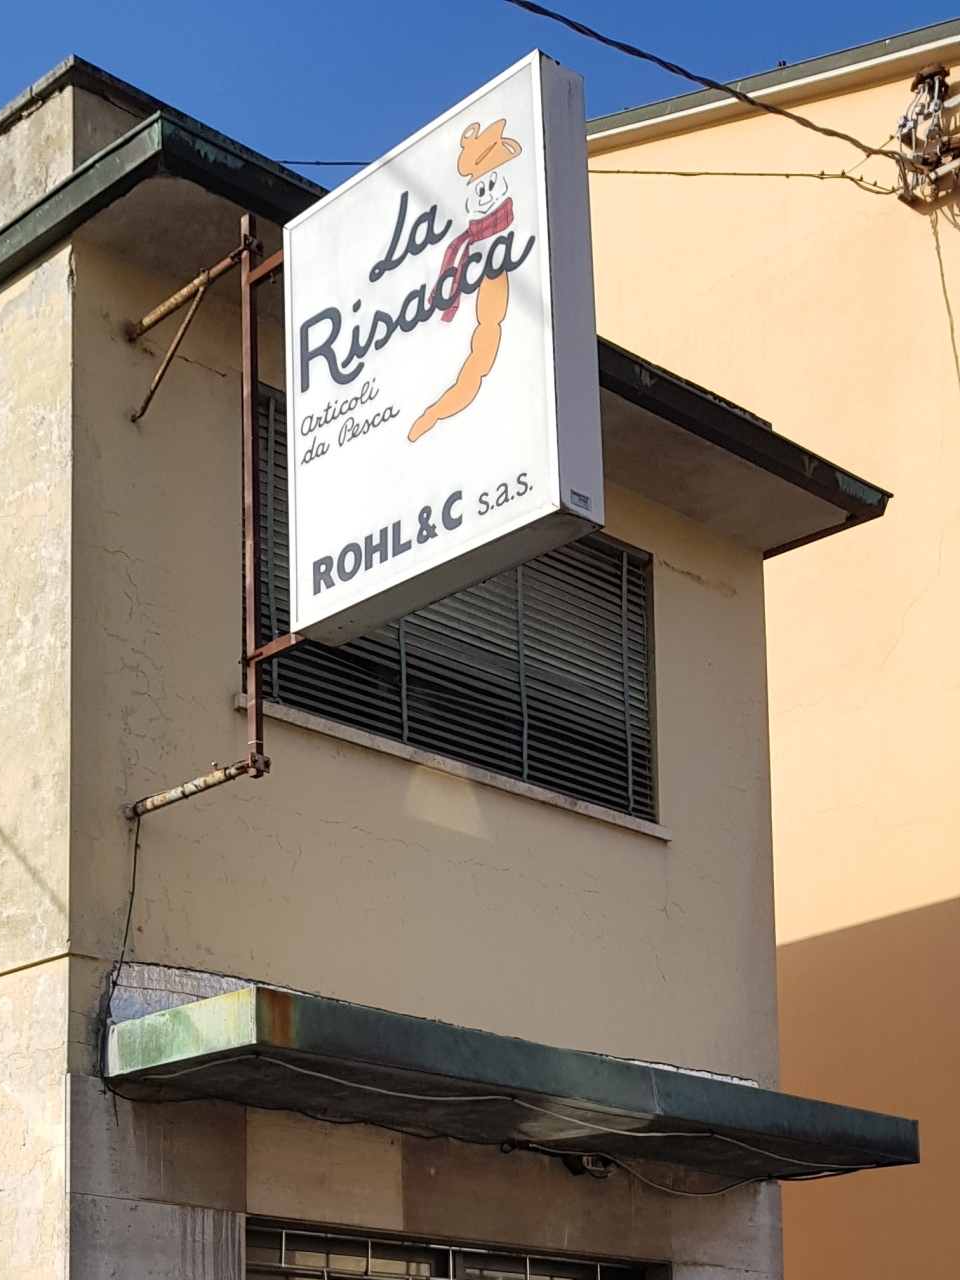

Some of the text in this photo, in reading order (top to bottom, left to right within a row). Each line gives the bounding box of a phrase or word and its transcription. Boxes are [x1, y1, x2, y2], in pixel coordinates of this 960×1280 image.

[368, 190, 453, 283] La
[300, 230, 536, 393] Risacca
[301, 405, 400, 465] da Pesca
[312, 517, 413, 597] ROHL
[478, 471, 534, 517] s.a.s.
